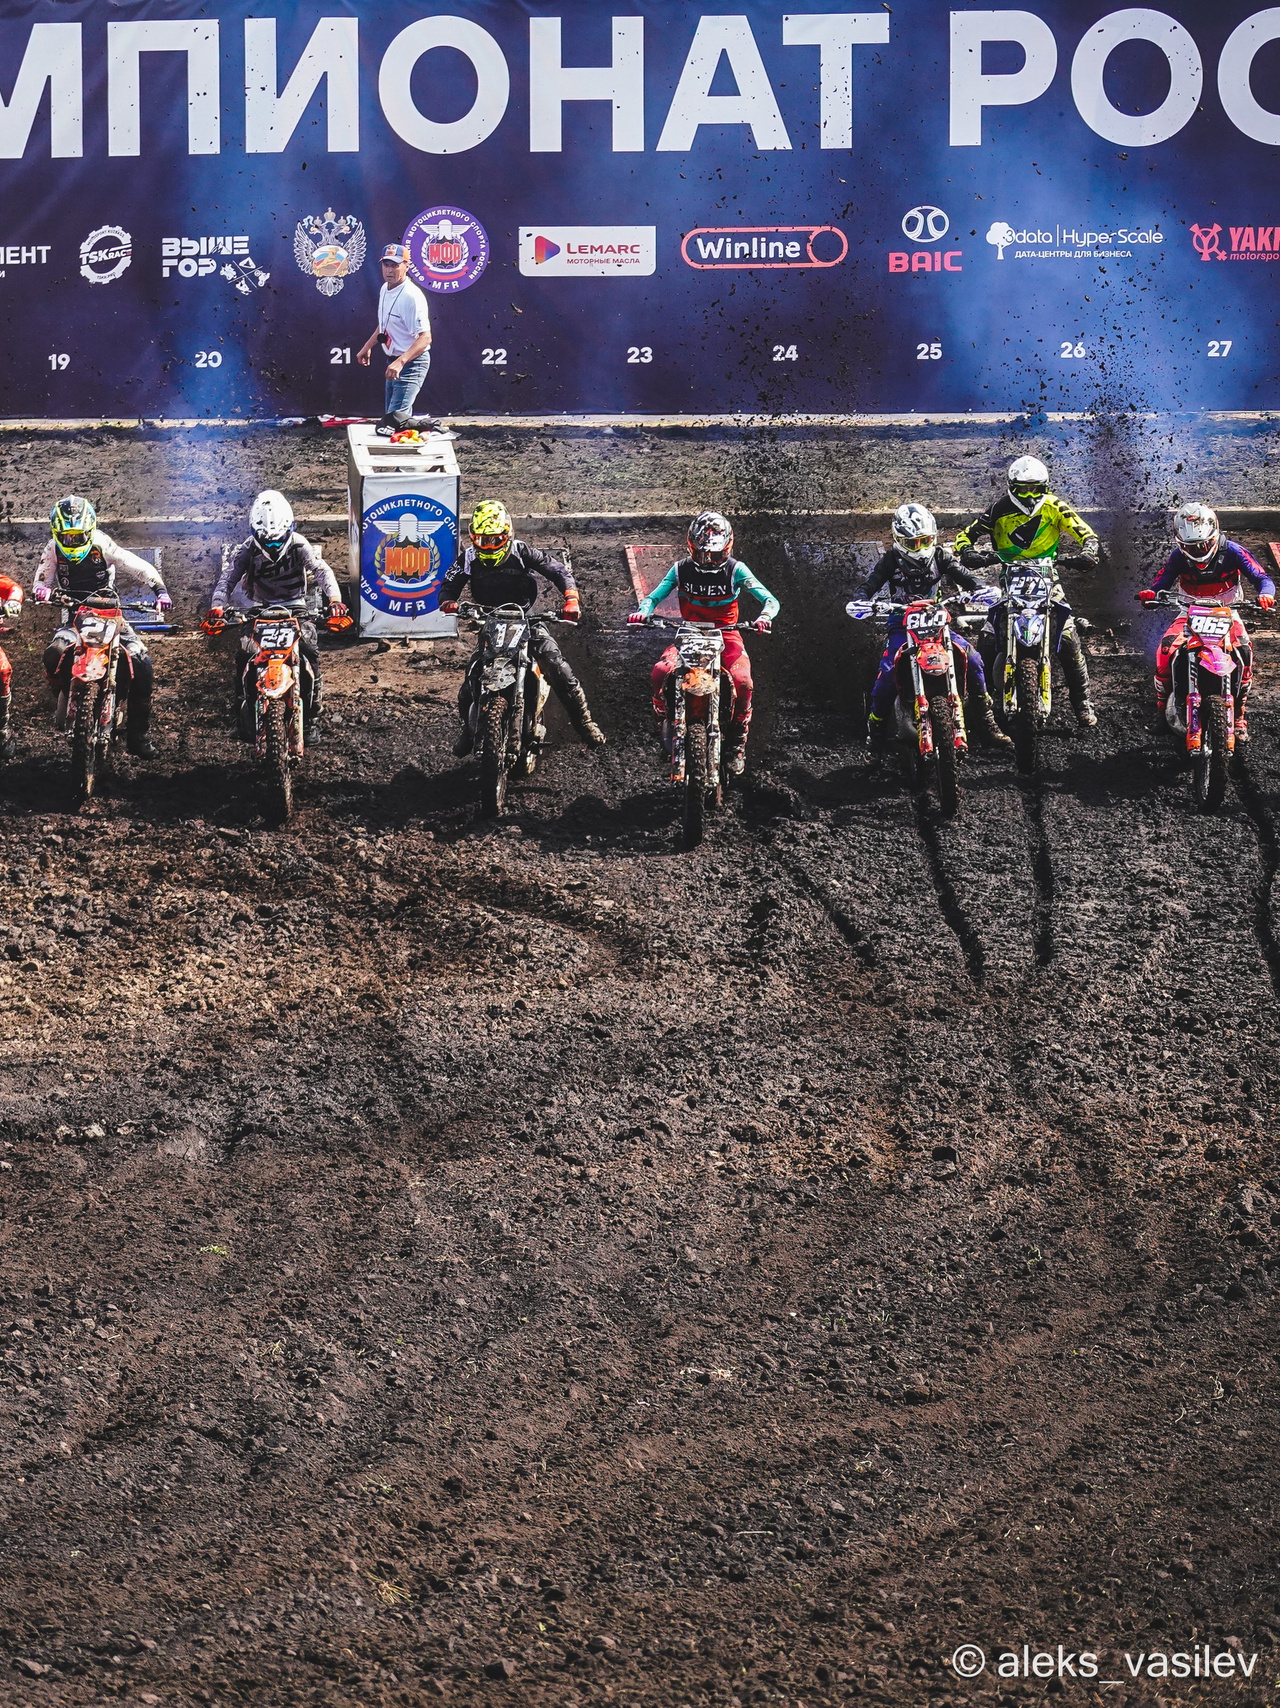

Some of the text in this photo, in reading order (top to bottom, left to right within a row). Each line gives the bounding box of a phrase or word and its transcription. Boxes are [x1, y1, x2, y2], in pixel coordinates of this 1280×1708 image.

[408, 209, 470, 237] МОТОЦИКЛЕТНОГО
[470, 221, 486, 249] СПОРТА
[162, 236, 249, 256] ВЫШЕ
[428, 242, 461, 264] МФР
[567, 242, 640, 254] LEMARC
[696, 237, 801, 259] Winline
[1074, 250, 1091, 258] ДЛЯ
[1093, 250, 1132, 258] БИЗНЕСА
[888, 251, 963, 273] BAIC
[1230, 252, 1280, 262] motorspo
[162, 258, 217, 278] ГОР
[468, 251, 486, 280] РОССИИ
[432, 280, 460, 290] MFR
[330, 348, 350, 363] 21
[482, 349, 507, 364] 22
[628, 347, 652, 363] 23
[773, 345, 798, 361] 24
[917, 344, 942, 359] 25
[1061, 342, 1086, 358] 26
[1208, 341, 1232, 356] 27
[49, 354, 70, 370] 19
[195, 351, 222, 367] 20
[362, 499, 443, 533] ОТОЦИКЛЕТНОГО
[443, 516, 457, 540] СПО
[385, 545, 430, 576] МФР
[389, 600, 426, 612] MFR
[79, 617, 117, 645] 21
[1191, 615, 1231, 635] 865
[494, 623, 527, 648] 17
